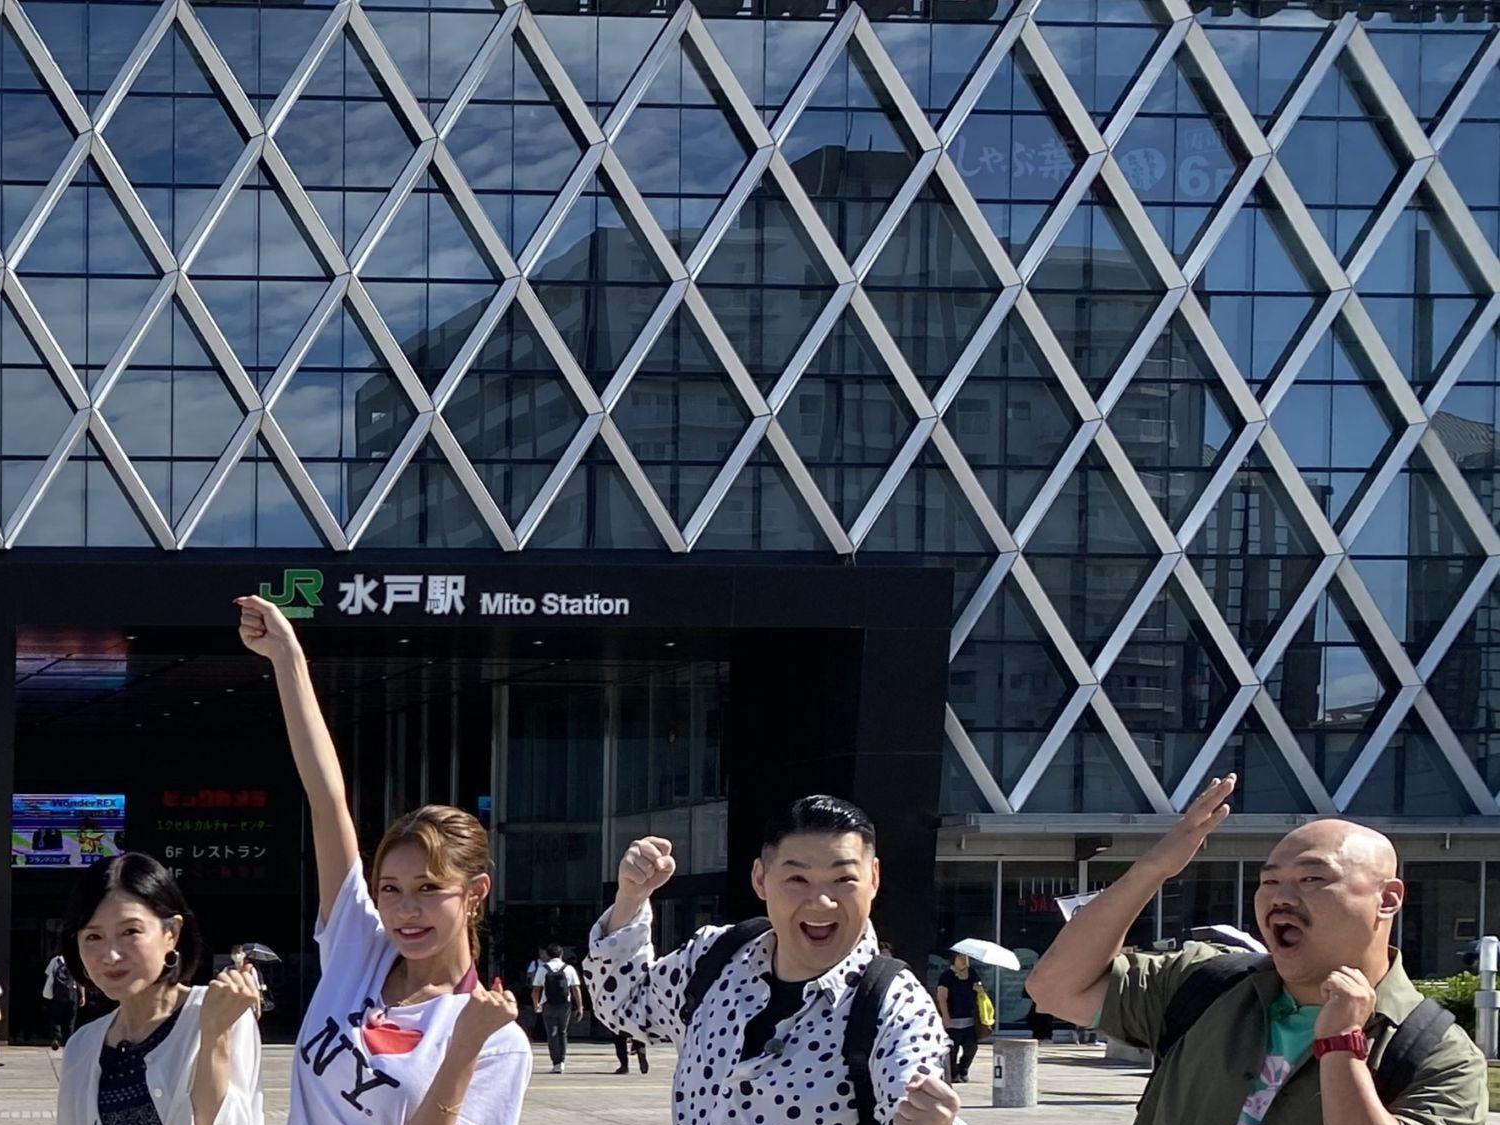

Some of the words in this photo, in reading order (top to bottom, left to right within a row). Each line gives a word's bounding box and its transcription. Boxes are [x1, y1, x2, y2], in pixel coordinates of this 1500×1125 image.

[259, 569, 324, 606] JR
[338, 574, 467, 615] 水戸駅
[480, 593, 537, 615] Mito
[542, 593, 630, 615] Station
[165, 845, 183, 859] 6F
[192, 845, 267, 859] レストラン
[301, 1016, 400, 1111] NY
